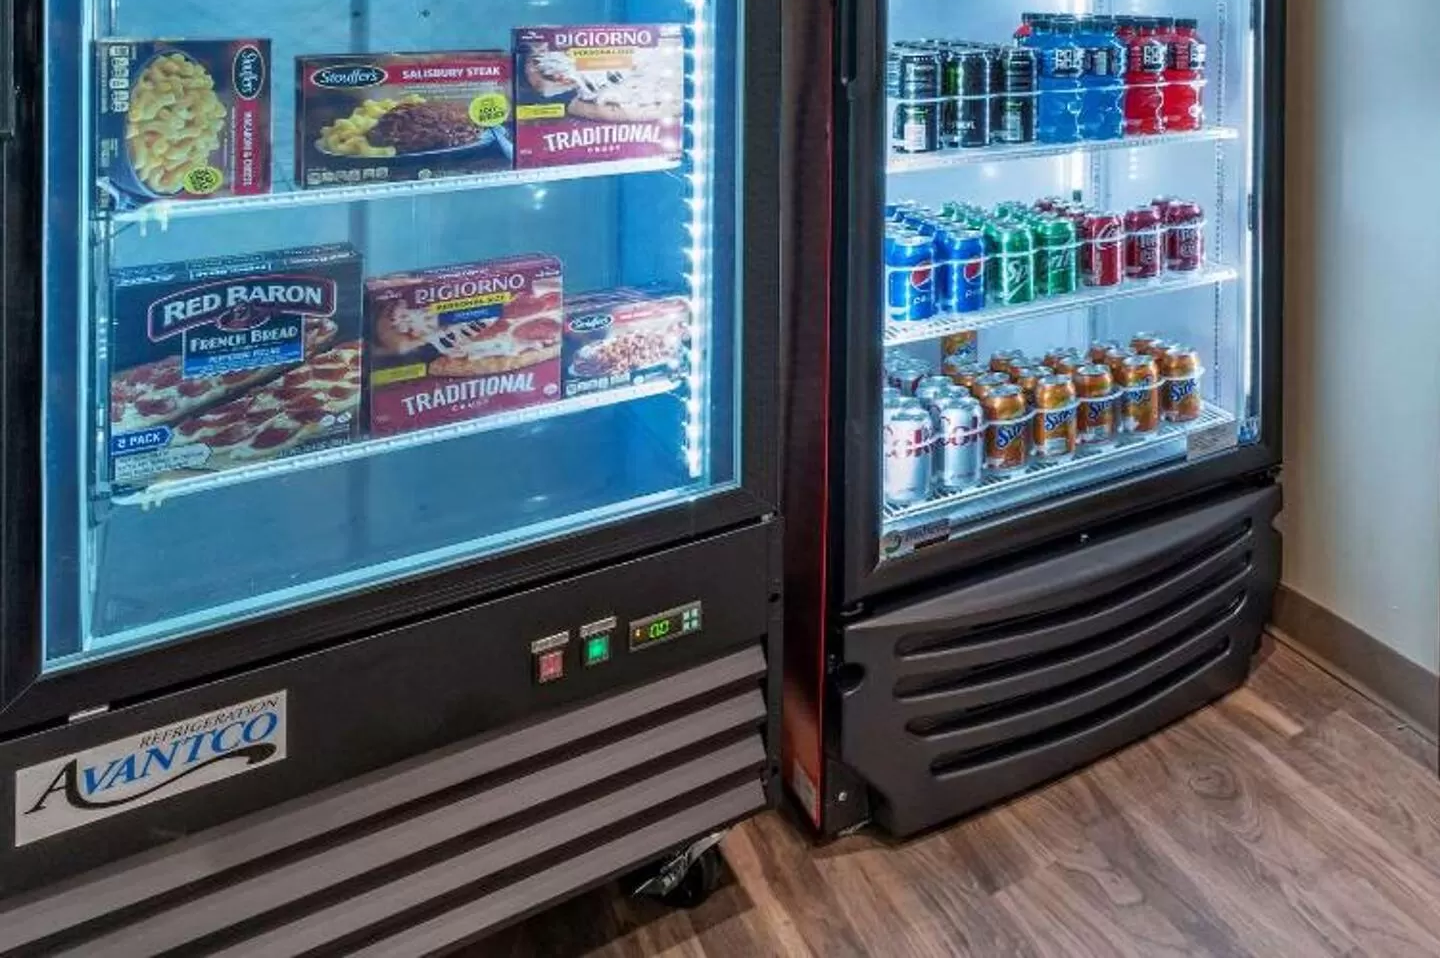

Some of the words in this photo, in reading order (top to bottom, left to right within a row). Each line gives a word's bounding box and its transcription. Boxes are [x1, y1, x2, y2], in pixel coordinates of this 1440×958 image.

[555, 29, 652, 47] DIGIORNO
[319, 67, 380, 85] Stouffer's
[402, 68, 464, 80] SALISBURY
[466, 65, 501, 77] STEAK
[543, 123, 662, 153] TRADITIONAL
[414, 273, 525, 304] DIGIORNO
[163, 294, 222, 327] RED
[226, 285, 323, 308] BARON
[189, 332, 247, 353] FRENCH
[250, 325, 298, 344] BREAD
[401, 372, 537, 416] TRADITIONAL
[138, 695, 280, 748] REFRIGERATION
[24, 711, 278, 815] AVANTCO
